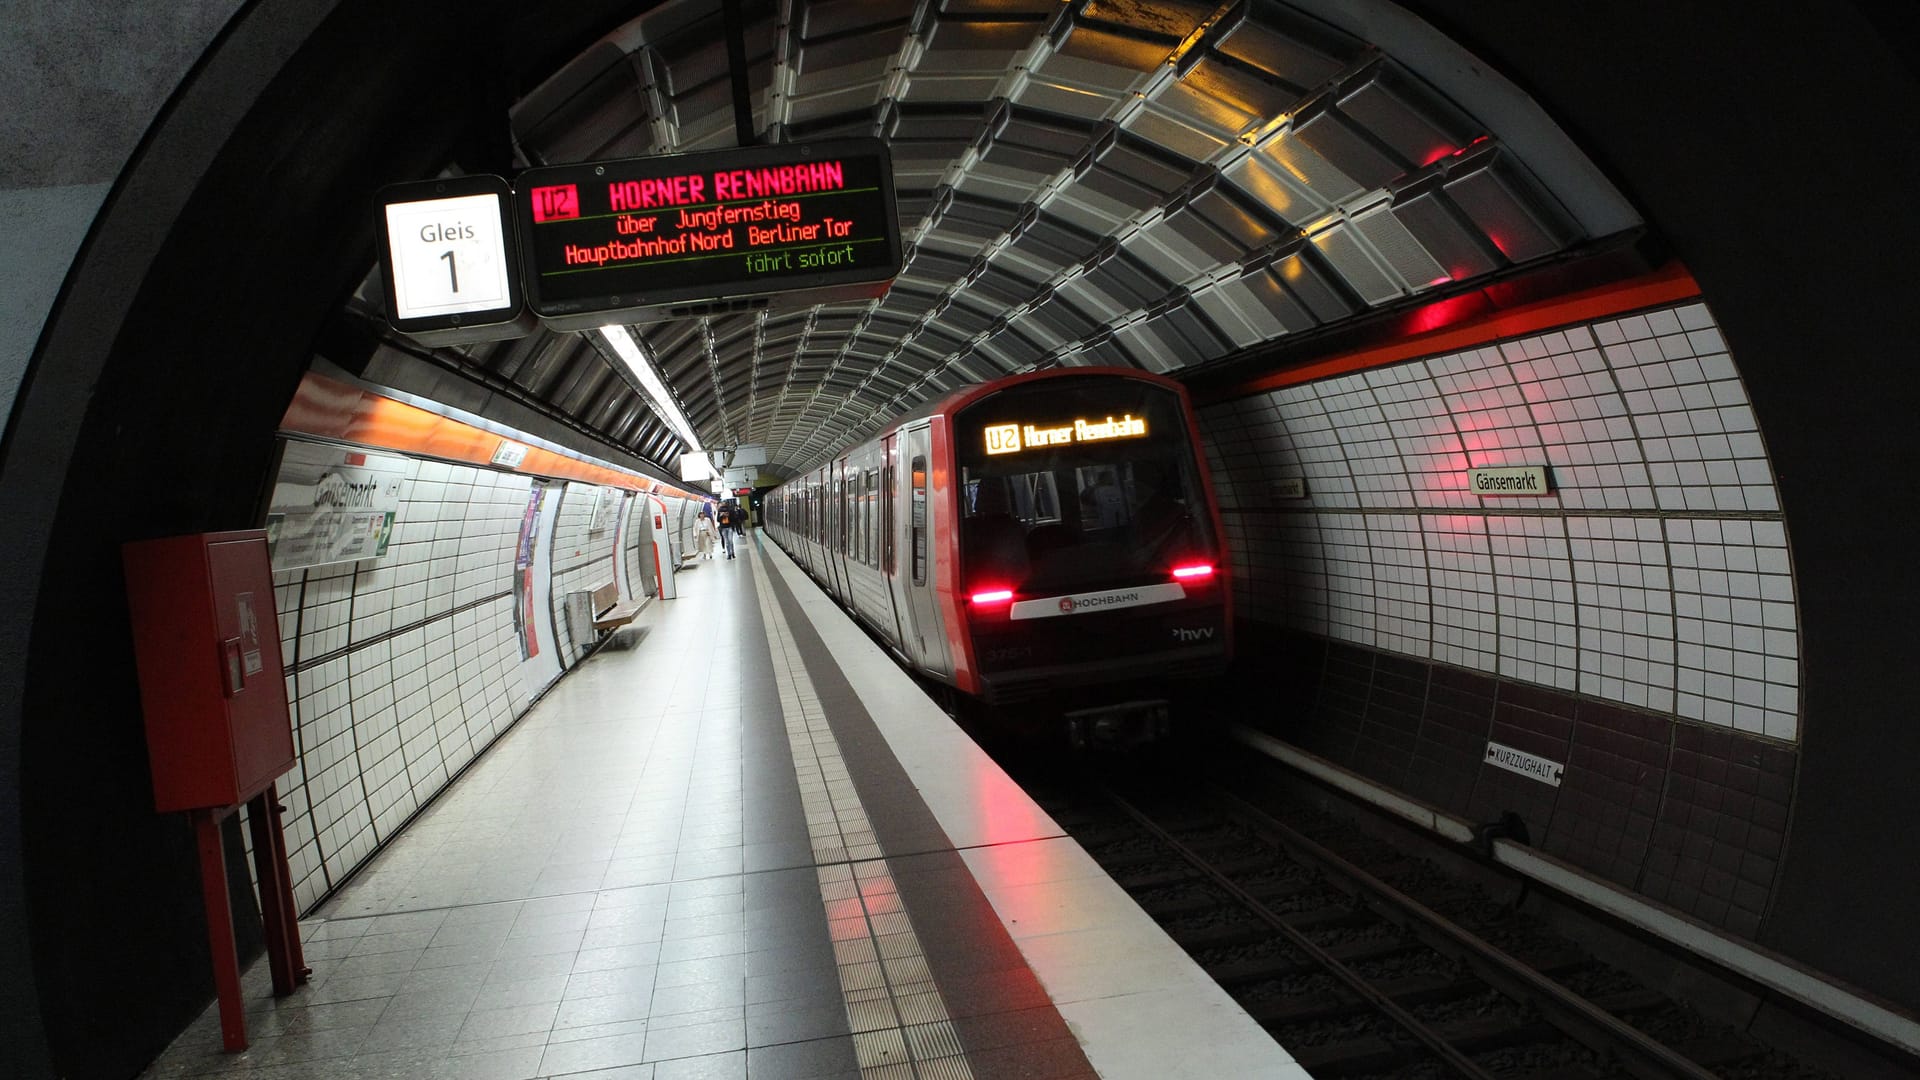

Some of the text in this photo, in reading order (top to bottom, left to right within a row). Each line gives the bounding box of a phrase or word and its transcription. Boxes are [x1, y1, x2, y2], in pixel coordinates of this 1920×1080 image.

[540, 160, 844, 218] U2 HORNER RENNBAHN
[420, 221, 474, 243] Gleis
[616, 200, 801, 235] über Jungfernstieg
[564, 217, 853, 267] Hauptbahnhof Nord Berliner Tor
[440, 250, 458, 293] 1
[746, 244, 856, 274] fährt sofort
[987, 426, 1018, 451] U2
[1023, 425, 1074, 447] Horner
[1475, 471, 1538, 491] Gänsemarkt
[1073, 592, 1139, 609] HOCHBAHN
[1179, 626, 1214, 642] hvv
[1494, 748, 1552, 778] KURZZUGHALT
